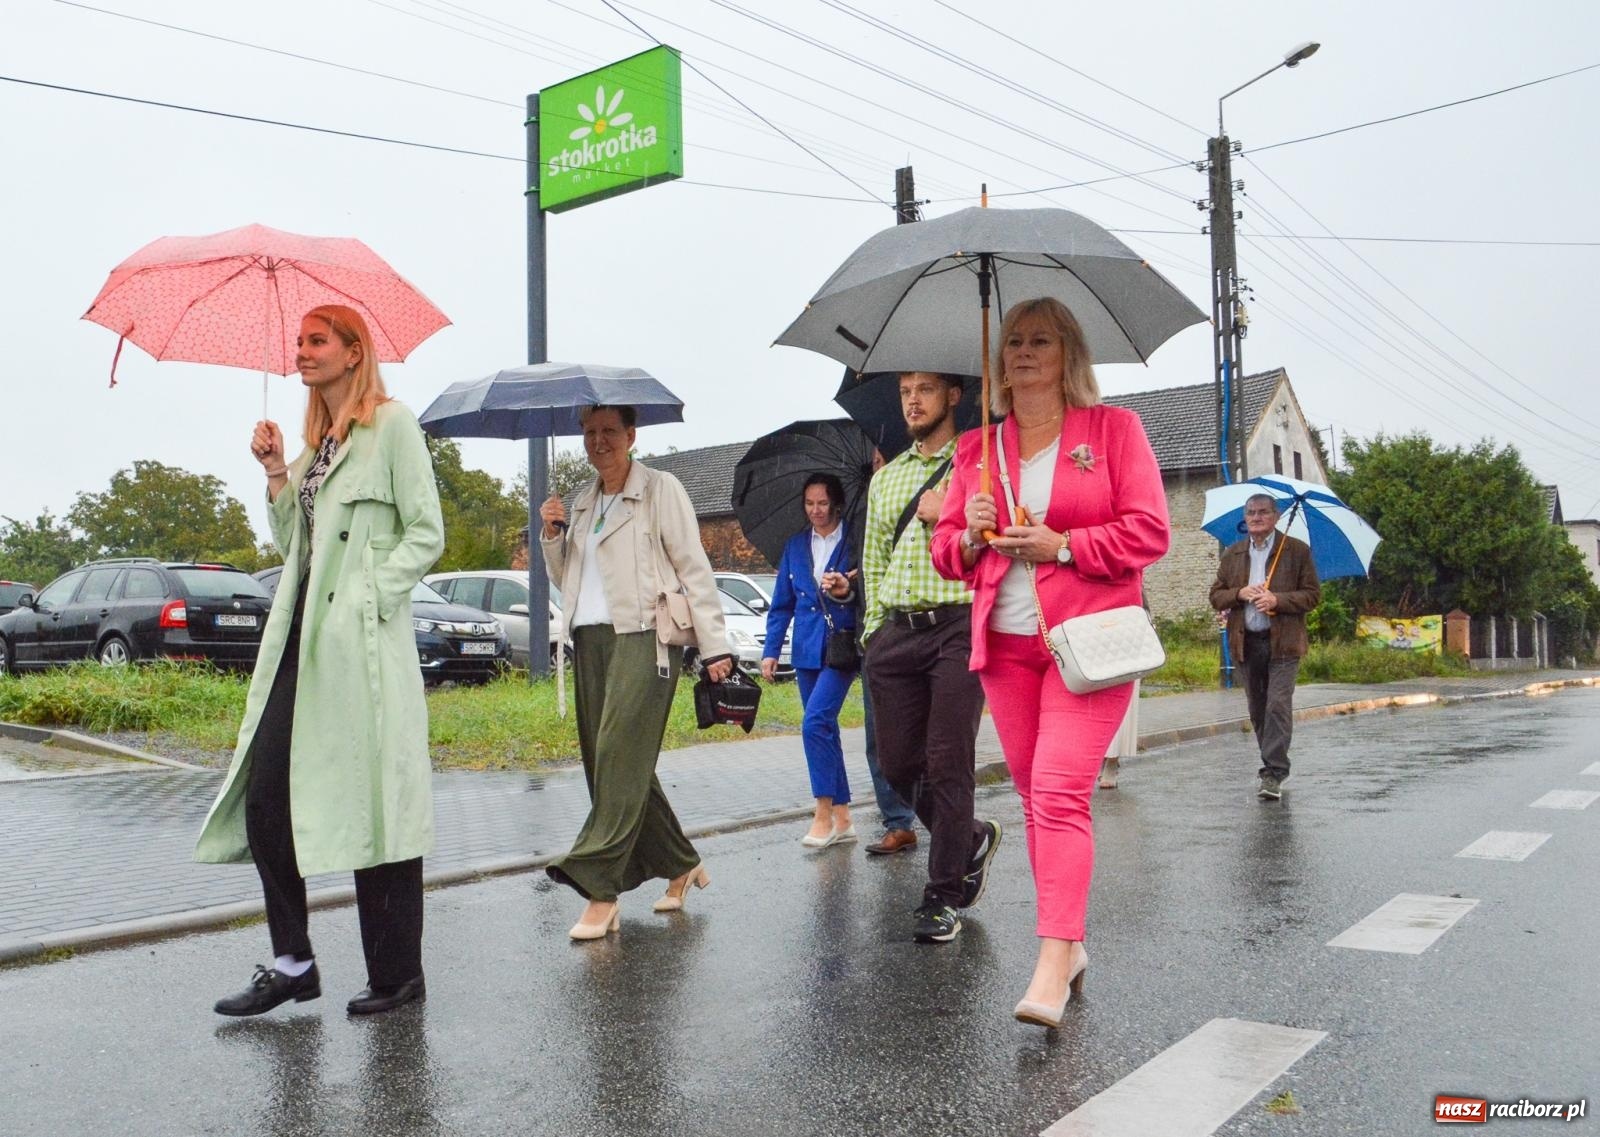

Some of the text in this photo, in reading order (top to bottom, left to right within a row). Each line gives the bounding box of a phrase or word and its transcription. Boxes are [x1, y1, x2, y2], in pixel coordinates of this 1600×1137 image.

[548, 123, 658, 177] stokrotka
[572, 157, 630, 184] market
[220, 615, 235, 625] SRC
